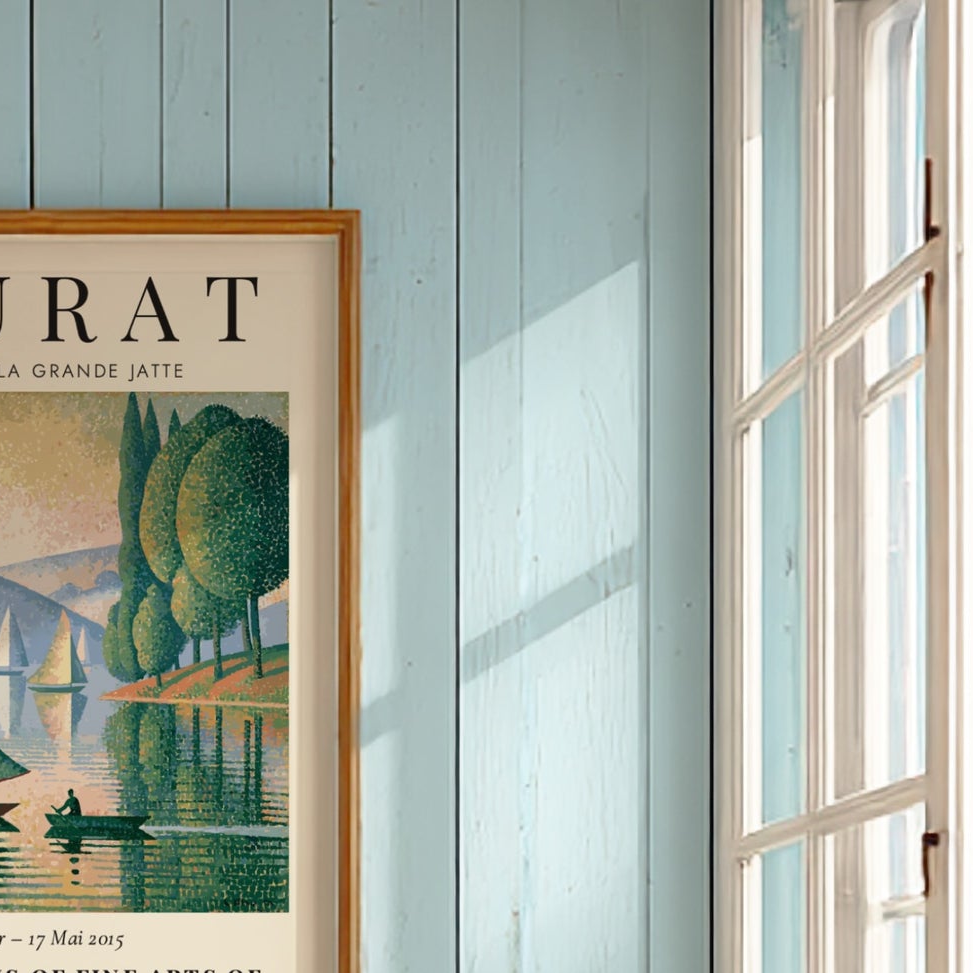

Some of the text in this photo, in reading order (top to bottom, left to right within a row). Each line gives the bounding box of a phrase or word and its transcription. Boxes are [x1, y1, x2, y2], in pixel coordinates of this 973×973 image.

[31, 363, 118, 379] GRANDE
[127, 363, 183, 383] JATTE
[28, 934, 46, 952] 17
[50, 929, 84, 946] Mai
[87, 934, 125, 952] 2015
